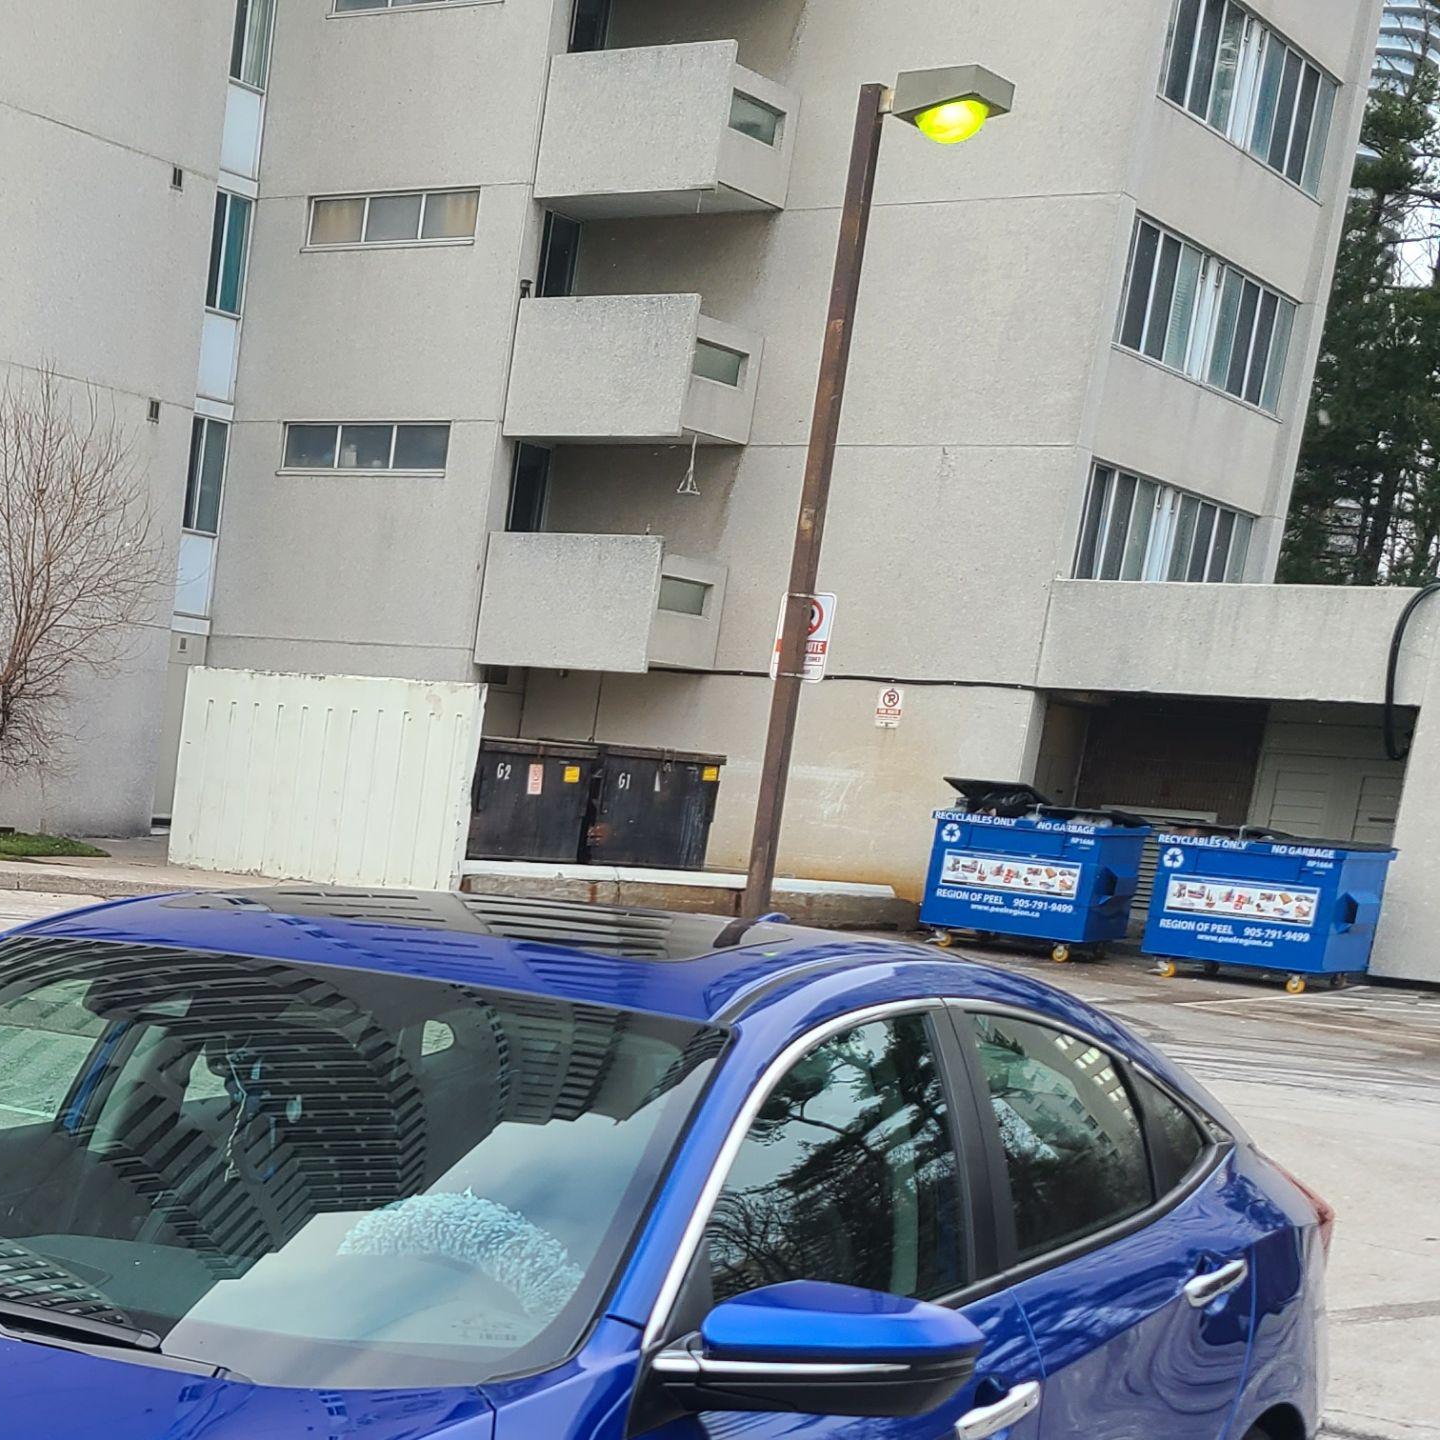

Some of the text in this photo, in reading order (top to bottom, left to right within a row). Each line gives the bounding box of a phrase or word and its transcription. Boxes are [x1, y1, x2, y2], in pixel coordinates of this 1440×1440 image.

[497, 762, 512, 780] G2
[935, 811, 1016, 827] RECYCLABLES ONLY
[1037, 822, 1096, 835] NO GARBAGE
[1158, 834, 1248, 850] RECYCLABLES ONLY
[1271, 845, 1335, 859] NO GARBAGE
[936, 888, 968, 900] REGION
[970, 891, 982, 902] OF
[984, 893, 1004, 905] PEEL
[1013, 898, 1074, 913] 905-791-9499
[970, 904, 1040, 918] www.peelregion.ca
[1159, 918, 1310, 942] REGION OF PEEL 905-791-9499
[1197, 934, 1273, 947] www.peelregion.ca
